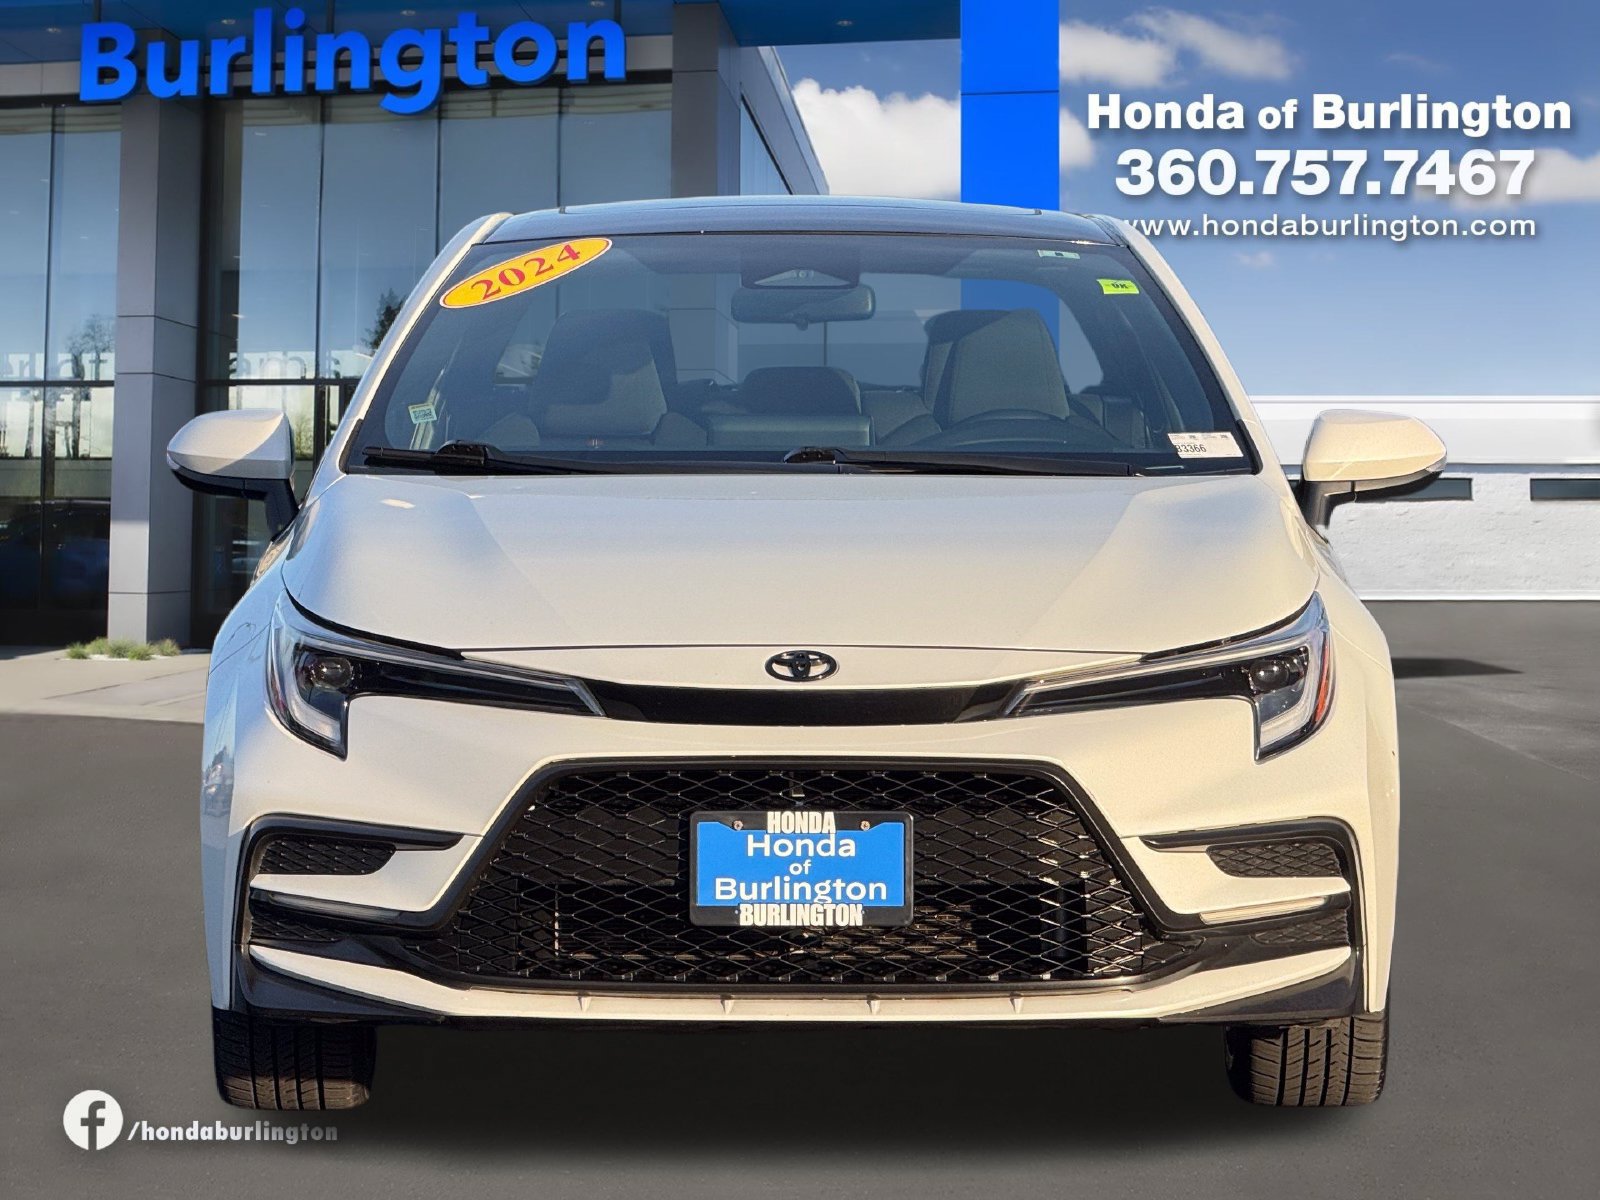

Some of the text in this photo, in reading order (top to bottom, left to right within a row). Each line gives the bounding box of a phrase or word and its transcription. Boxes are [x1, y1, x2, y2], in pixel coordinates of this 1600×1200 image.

[79, 6, 626, 116] Burlington
[470, 244, 581, 300] 2024
[766, 811, 837, 834] HONDA
[746, 833, 857, 857] Honda
[788, 859, 813, 875] of
[714, 876, 888, 904] Burlington
[738, 903, 864, 927] BURLINGTON
